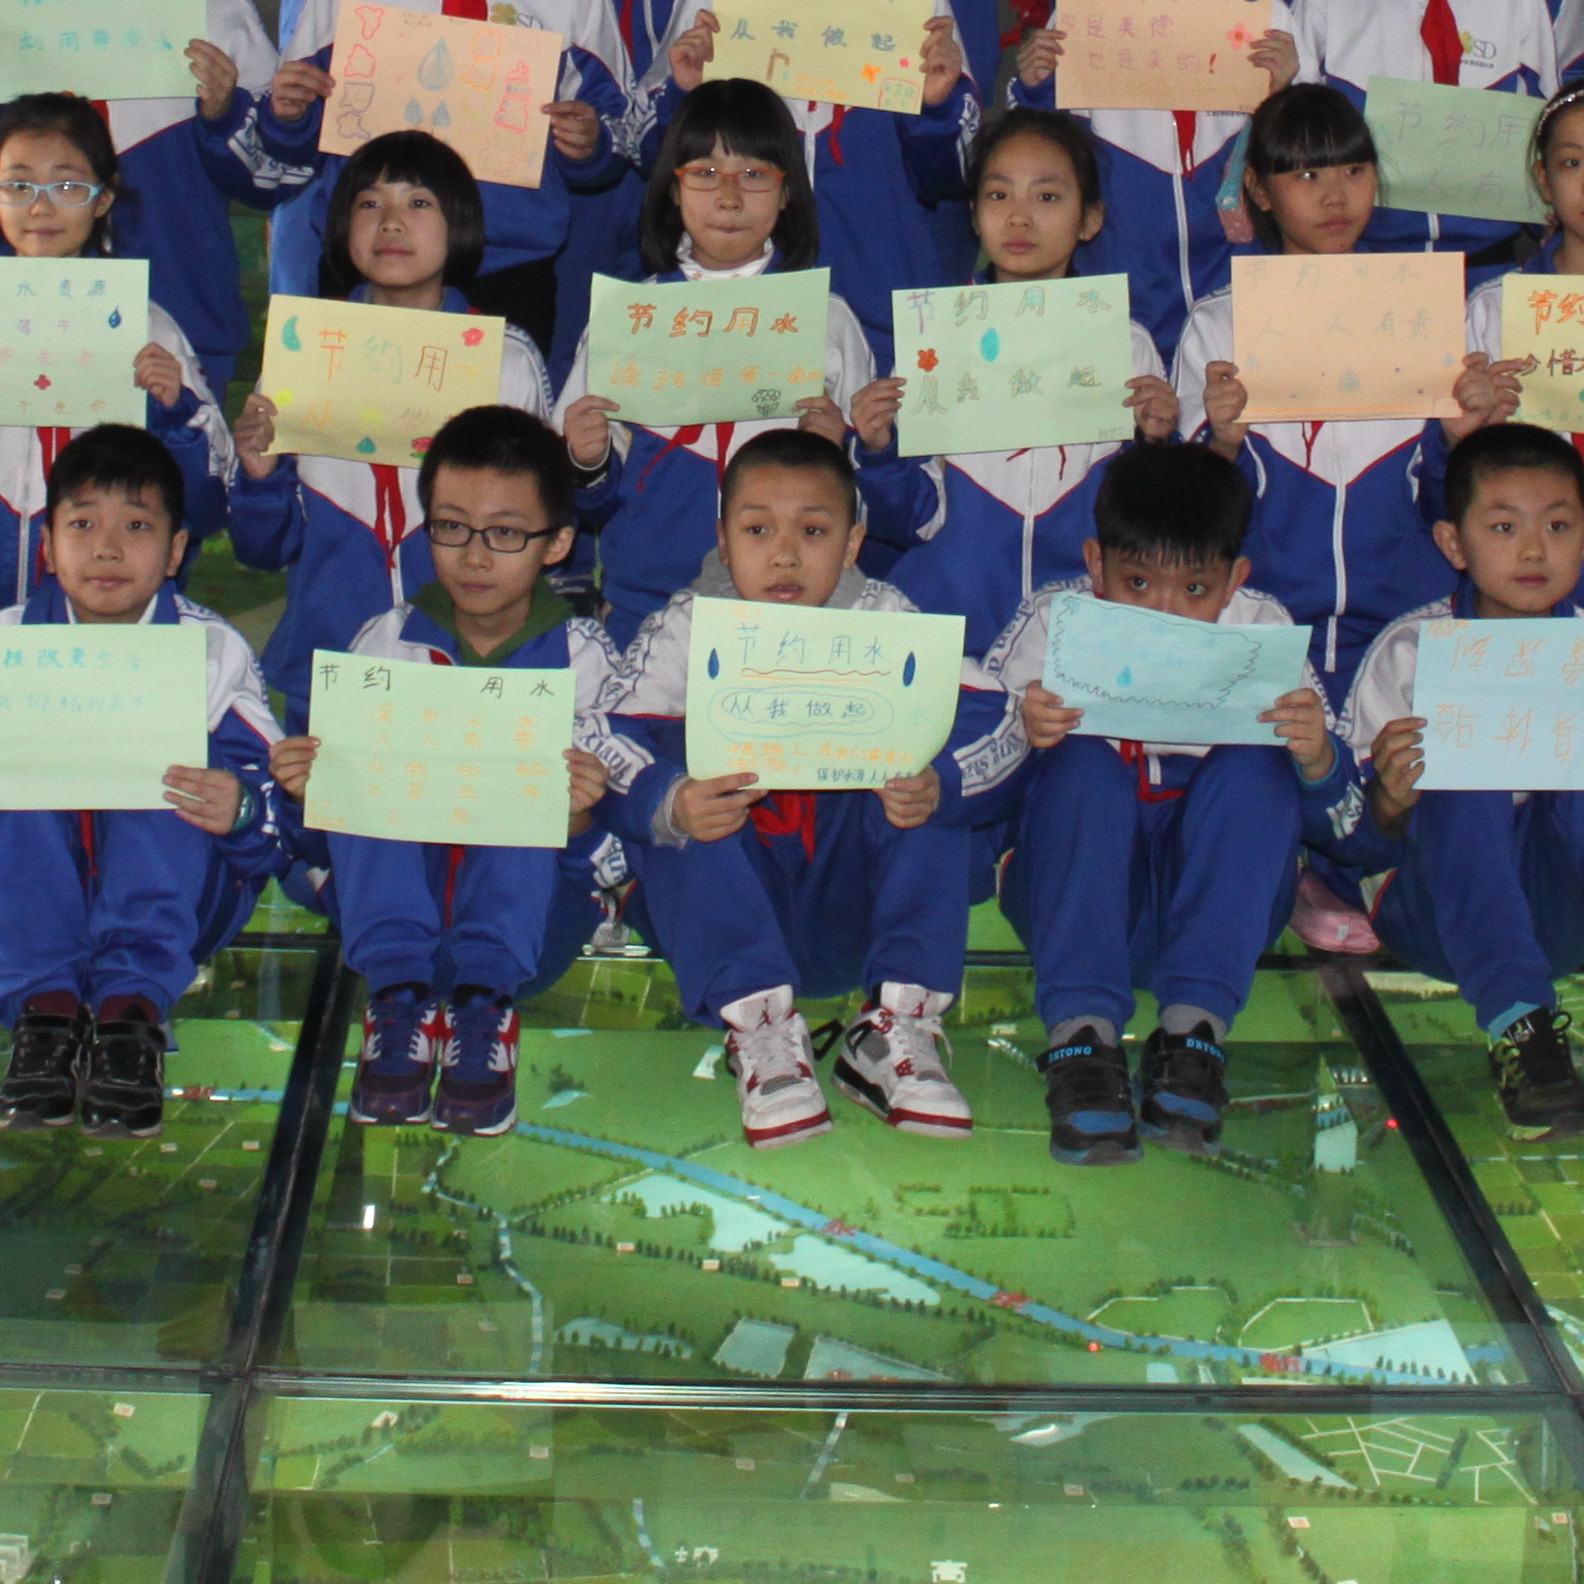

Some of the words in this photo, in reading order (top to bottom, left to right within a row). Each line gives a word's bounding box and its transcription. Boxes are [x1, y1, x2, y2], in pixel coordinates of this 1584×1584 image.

[729, 18, 897, 52] 从我做起
[626, 302, 799, 339] 节约用水
[906, 285, 1112, 335] 节约用水
[735, 622, 883, 665] 节约用水
[320, 664, 556, 699] 节约用水
[729, 694, 868, 719] 从我做起
